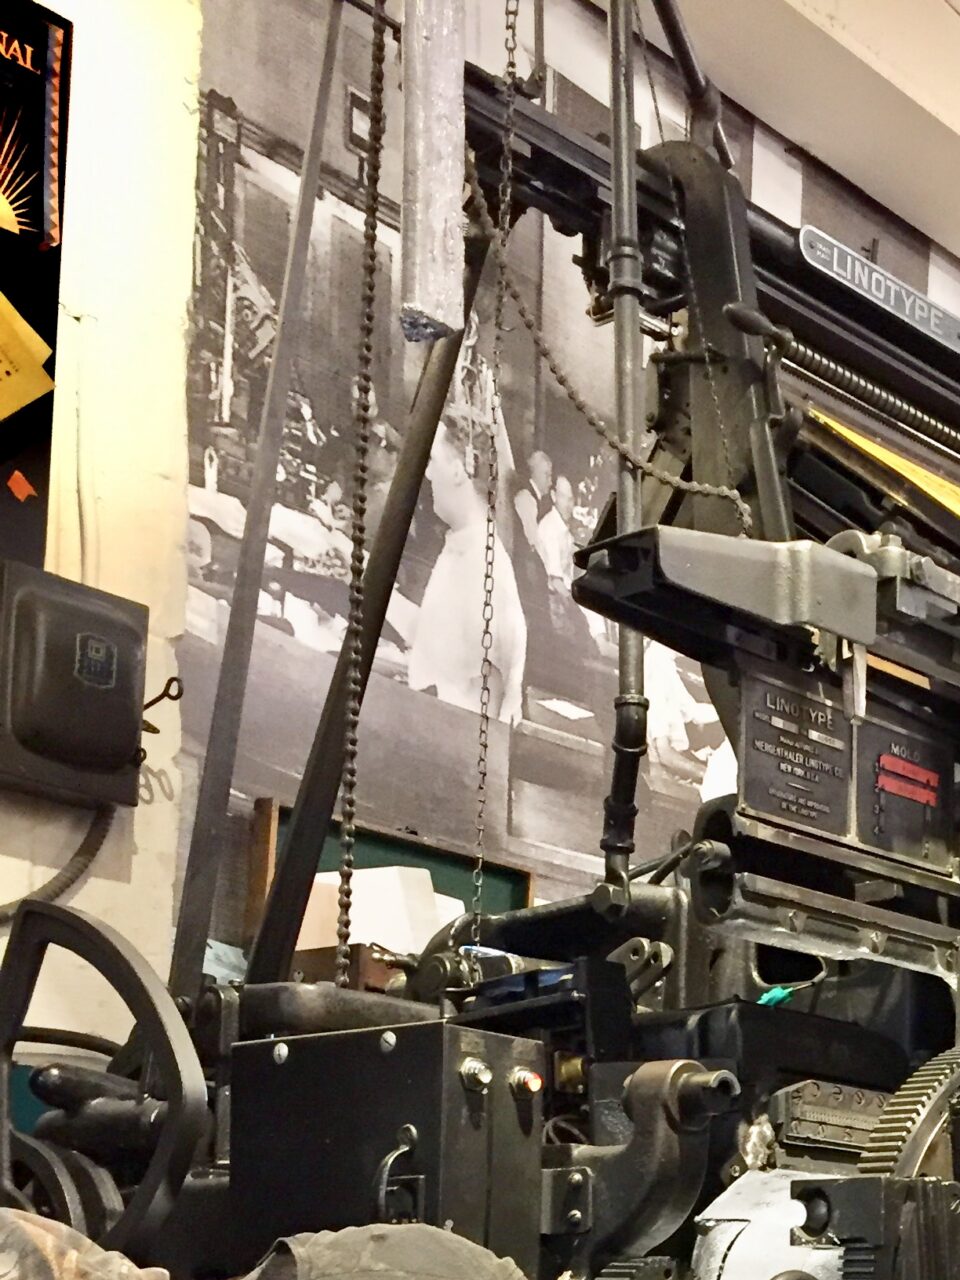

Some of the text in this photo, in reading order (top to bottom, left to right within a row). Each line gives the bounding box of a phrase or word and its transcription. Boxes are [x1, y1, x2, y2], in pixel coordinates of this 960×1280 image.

[833, 246, 944, 336] LINOTYPE
[766, 692, 834, 731] LINOTYPE
[891, 742, 919, 762] MOLD
